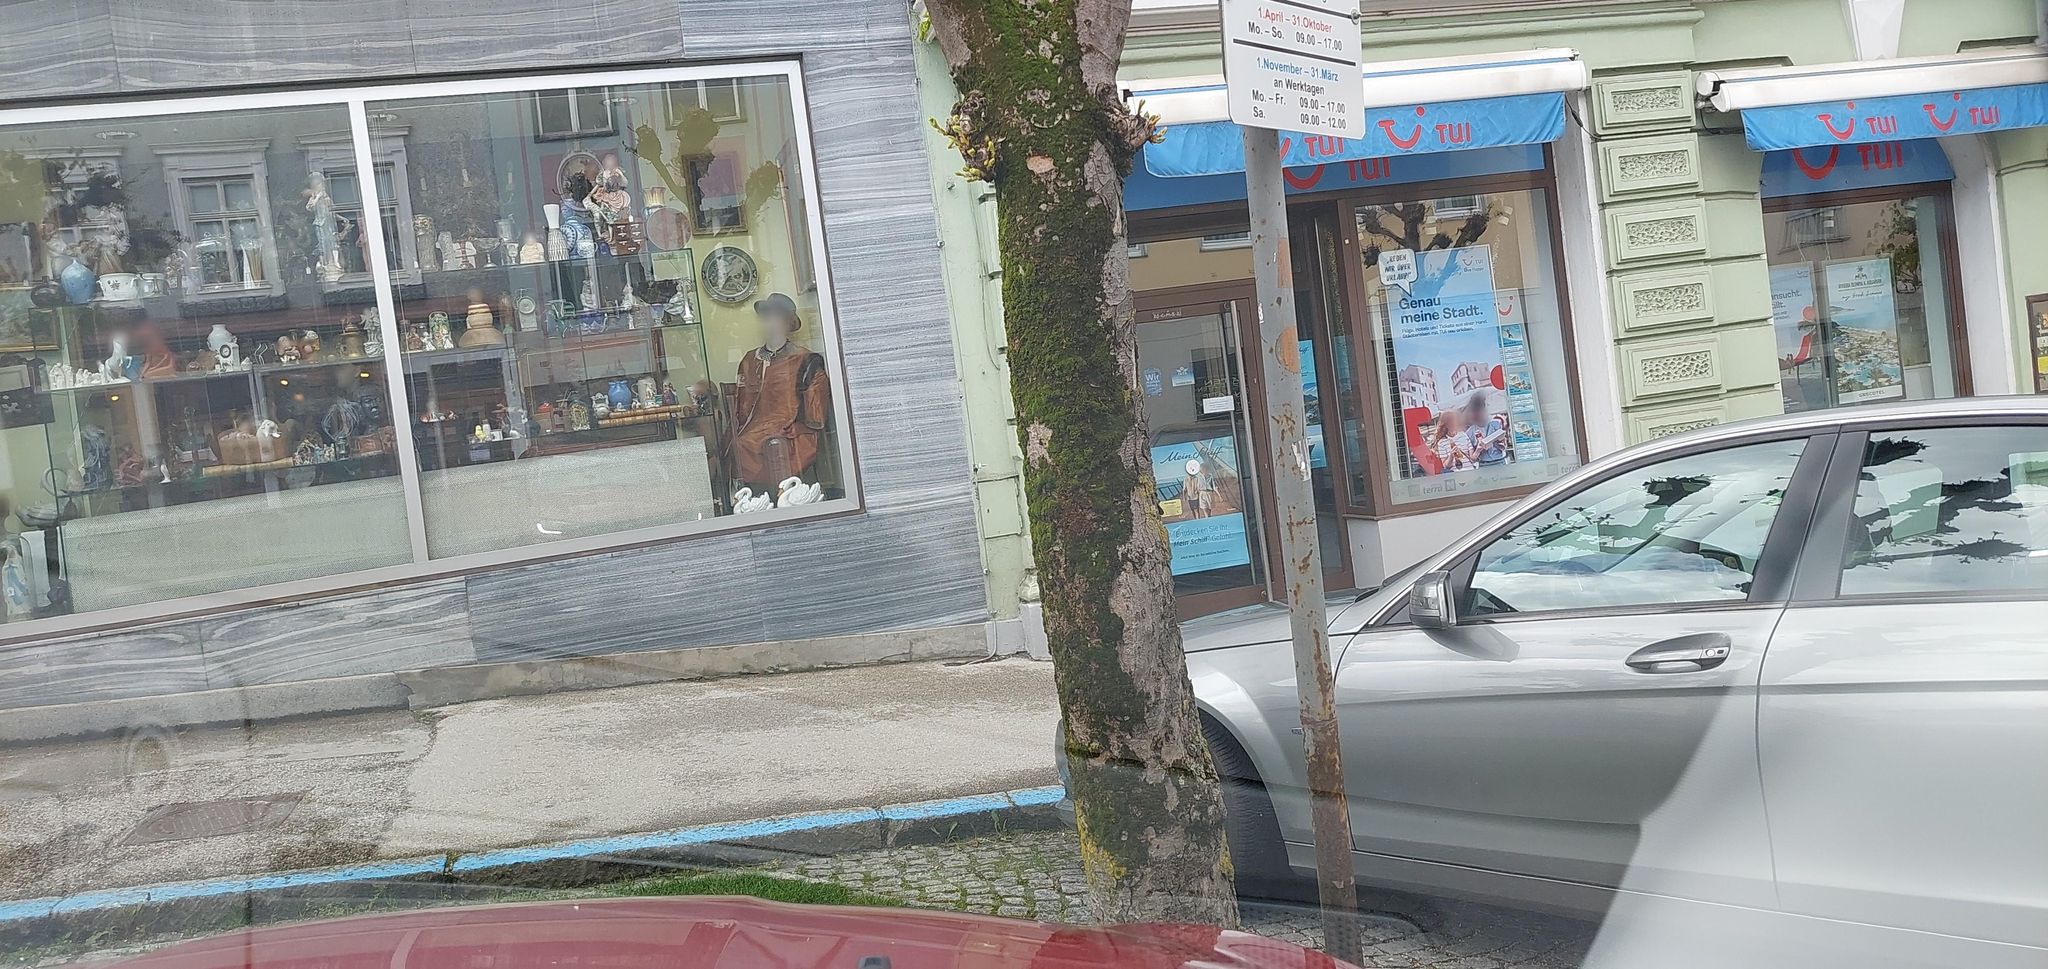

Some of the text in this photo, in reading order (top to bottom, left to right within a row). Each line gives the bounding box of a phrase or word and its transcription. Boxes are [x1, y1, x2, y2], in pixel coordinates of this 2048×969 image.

[1258, 7, 1284, 23] 1.April
[1292, 14, 1333, 33] 31.Oktober
[1248, 22, 1263, 35] Mo.
[1271, 26, 1285, 39] So.
[1296, 31, 1316, 45] 09.00
[1324, 38, 1342, 51] 17.00
[1256, 57, 1302, 75] 1.November
[1310, 68, 1339, 82] 31.März
[1274, 78, 1325, 96] an Werktagen
[1252, 89, 1267, 102] Mo.
[1275, 94, 1286, 106] Fr.
[1300, 97, 1319, 110] 09.00
[1327, 101, 1346, 114] 17.00
[1253, 106, 1266, 118] Sa.
[1300, 113, 1320, 126] 09.00
[1328, 117, 1346, 130] 12.00
[1865, 114, 1898, 135] TUI
[1968, 105, 2000, 126] TUI
[1435, 122, 1472, 144] TUI
[1304, 136, 1344, 158] TUI
[1856, 143, 1904, 170] TUI
[1344, 157, 1390, 182] TUI
[1399, 296, 1440, 310] Genau
[1401, 304, 1484, 324] meine Stadt.
[1145, 373, 1160, 382] Wir
[1160, 450, 1192, 464] Mein
[1174, 539, 1189, 548] Mein
